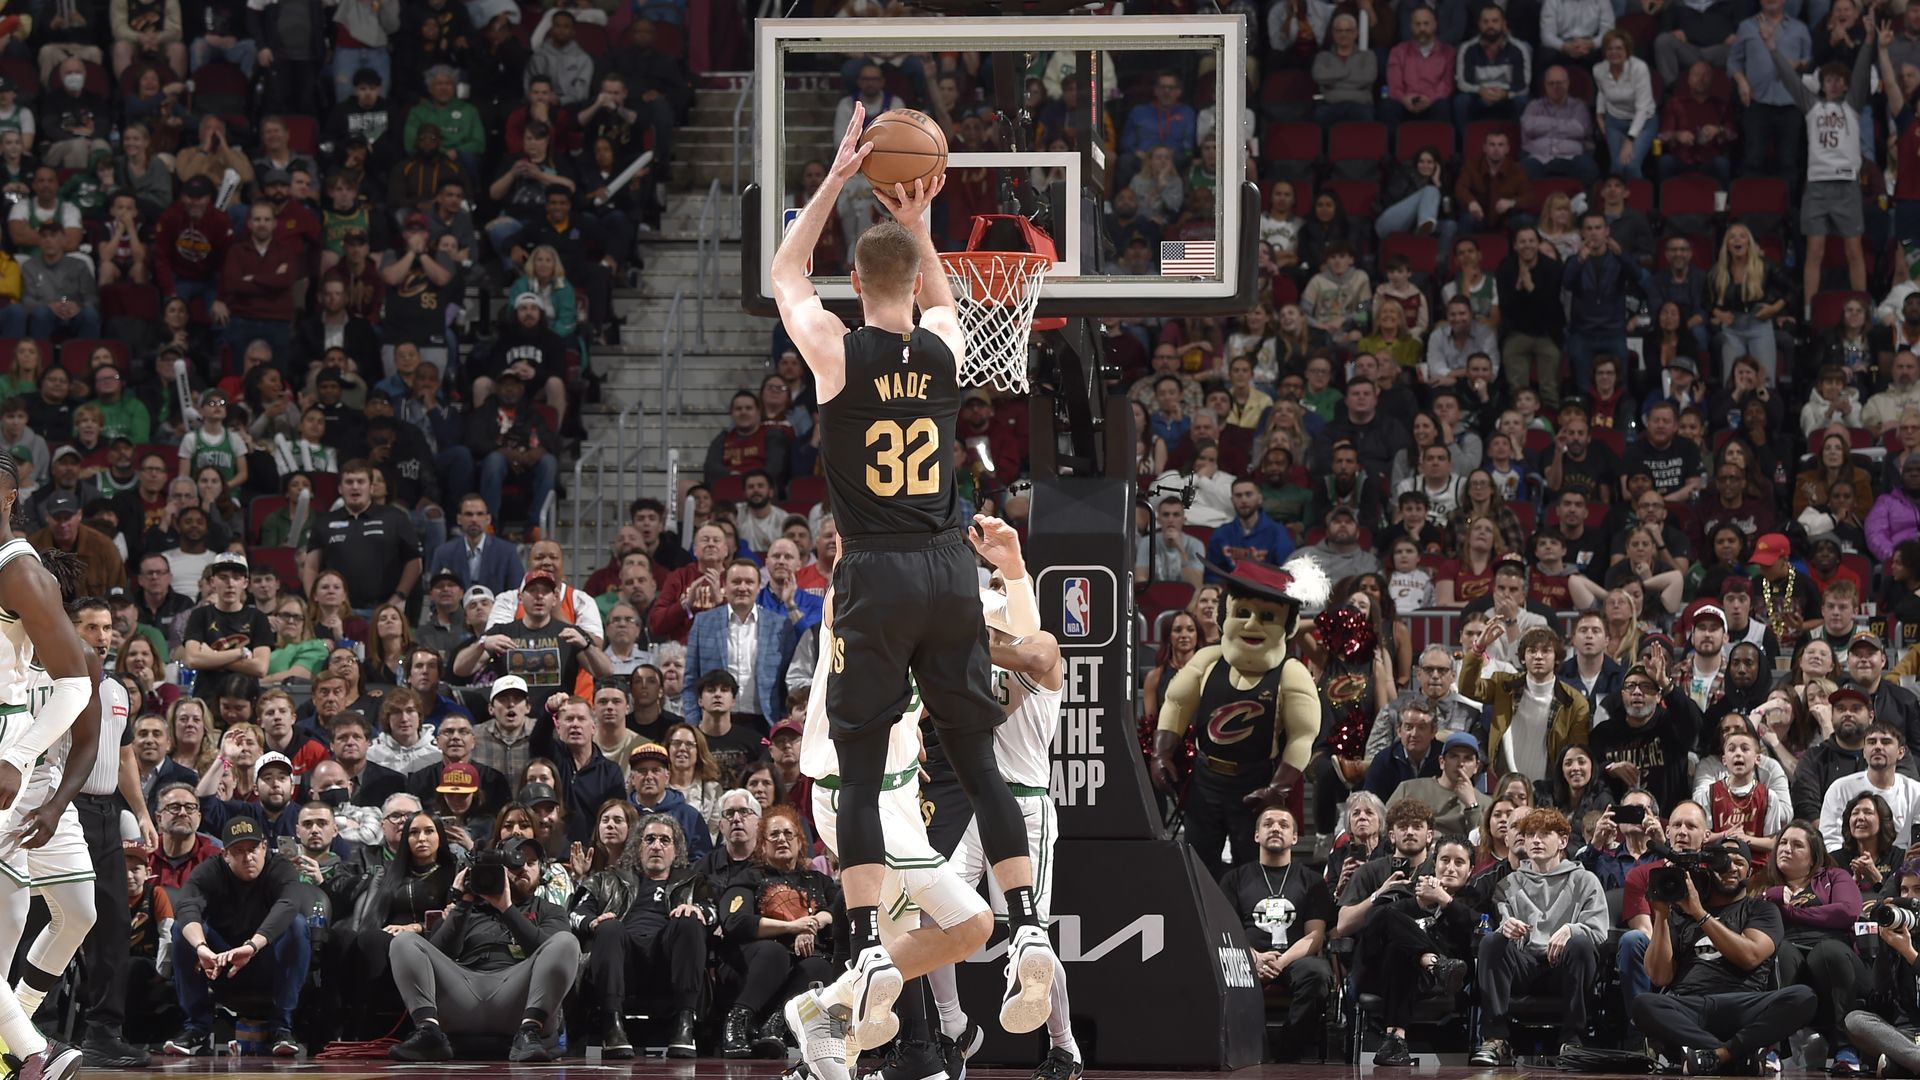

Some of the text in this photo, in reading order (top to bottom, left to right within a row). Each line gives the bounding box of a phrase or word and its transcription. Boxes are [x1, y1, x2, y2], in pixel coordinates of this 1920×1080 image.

[799, 77, 830, 91] 114
[1819, 131, 1839, 149] 45
[874, 371, 931, 402] WADE
[866, 417, 940, 497] 32
[1067, 623, 1081, 633] NBA
[535, 638, 559, 649] JAM
[1049, 760, 1105, 806] APP
[231, 821, 254, 836] CAVS
[1218, 931, 1255, 988] coinbase
